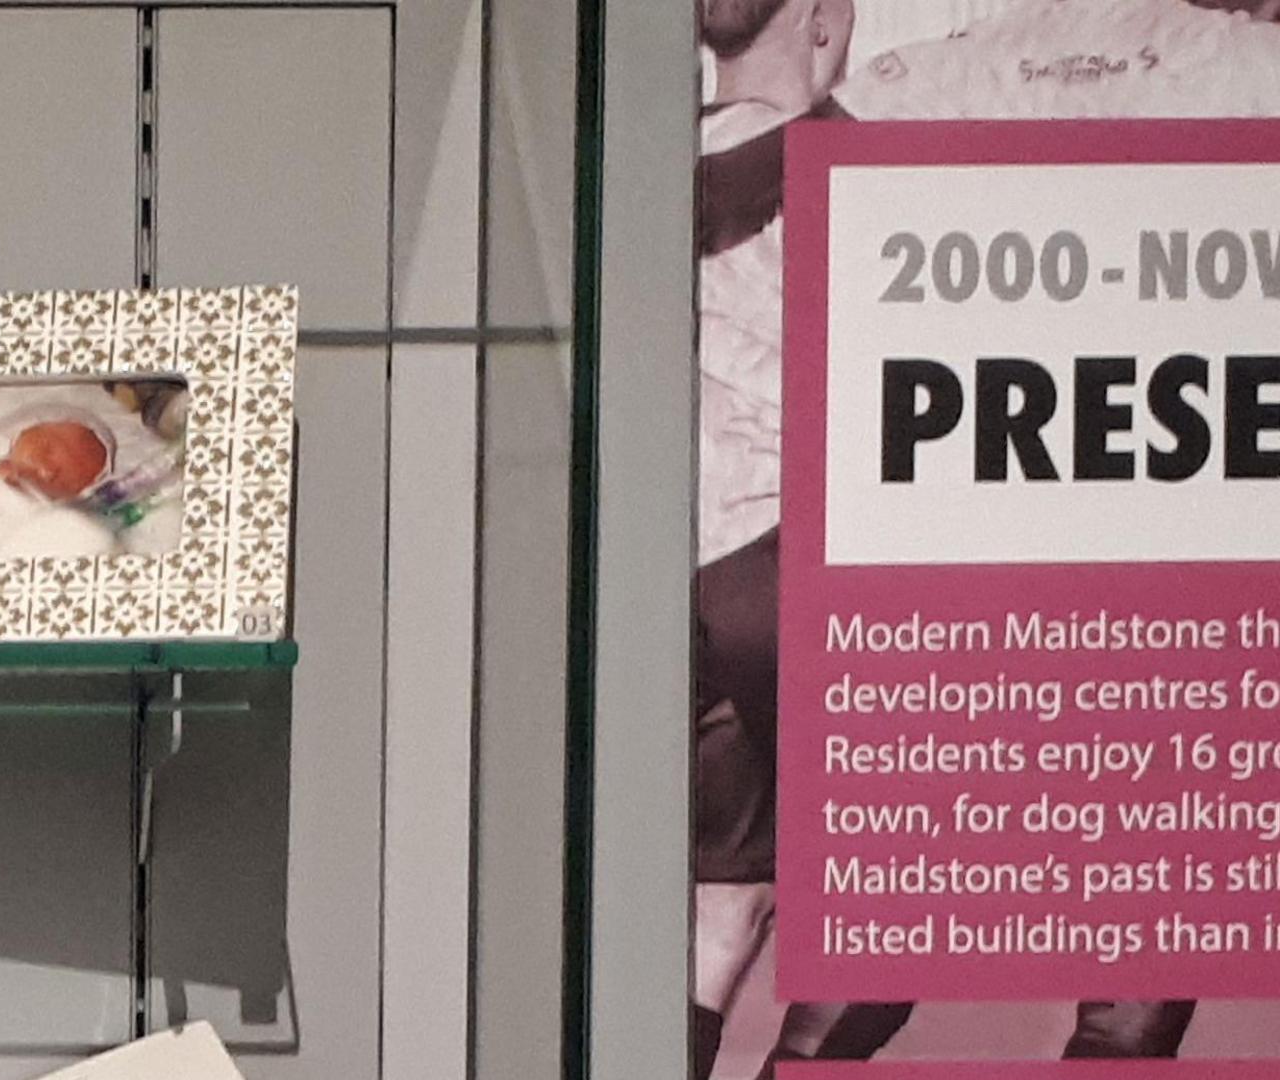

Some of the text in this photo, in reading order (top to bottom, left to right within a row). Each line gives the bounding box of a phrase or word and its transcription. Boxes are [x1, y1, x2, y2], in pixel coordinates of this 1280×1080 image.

[881, 354, 1280, 484] PRESE
[241, 613, 272, 635] 03
[826, 612, 990, 652] Modern
[1004, 610, 1225, 651] Maidstone
[825, 673, 1061, 720] developing
[1075, 679, 1227, 710] centres
[825, 734, 1025, 774] Residents
[1038, 733, 1154, 781] enjoy
[1171, 733, 1216, 770] 16
[823, 792, 1280, 841] town, for dog walking
[823, 854, 1070, 895] Maidstone’s
[1084, 857, 1171, 901] past
[1184, 854, 1213, 892] is
[823, 913, 1249, 962] listed buildings than
